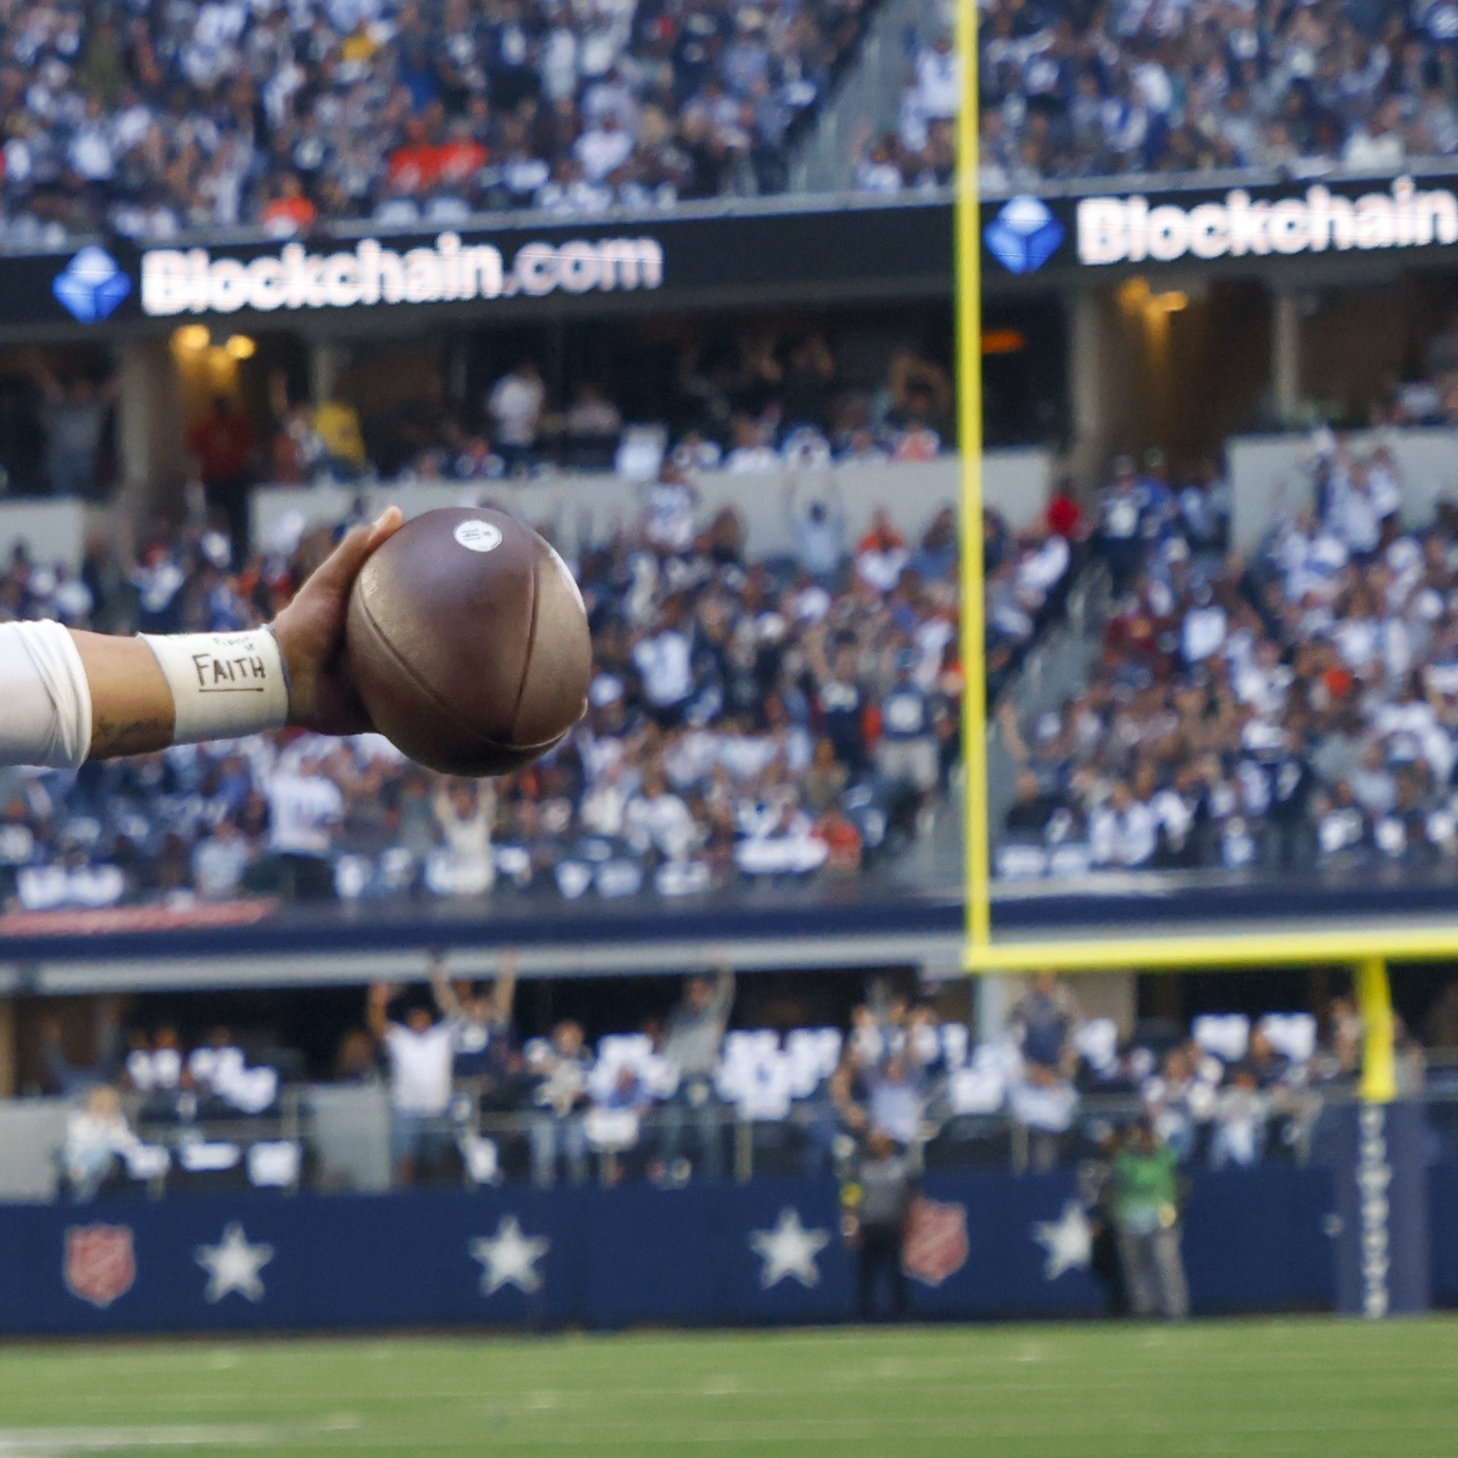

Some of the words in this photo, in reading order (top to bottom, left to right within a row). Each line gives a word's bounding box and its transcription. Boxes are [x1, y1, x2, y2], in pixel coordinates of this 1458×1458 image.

[1077, 175, 1458, 265] Blockchain
[141, 231, 664, 315] Blockchain.com
[192, 653, 266, 686] FAITH
